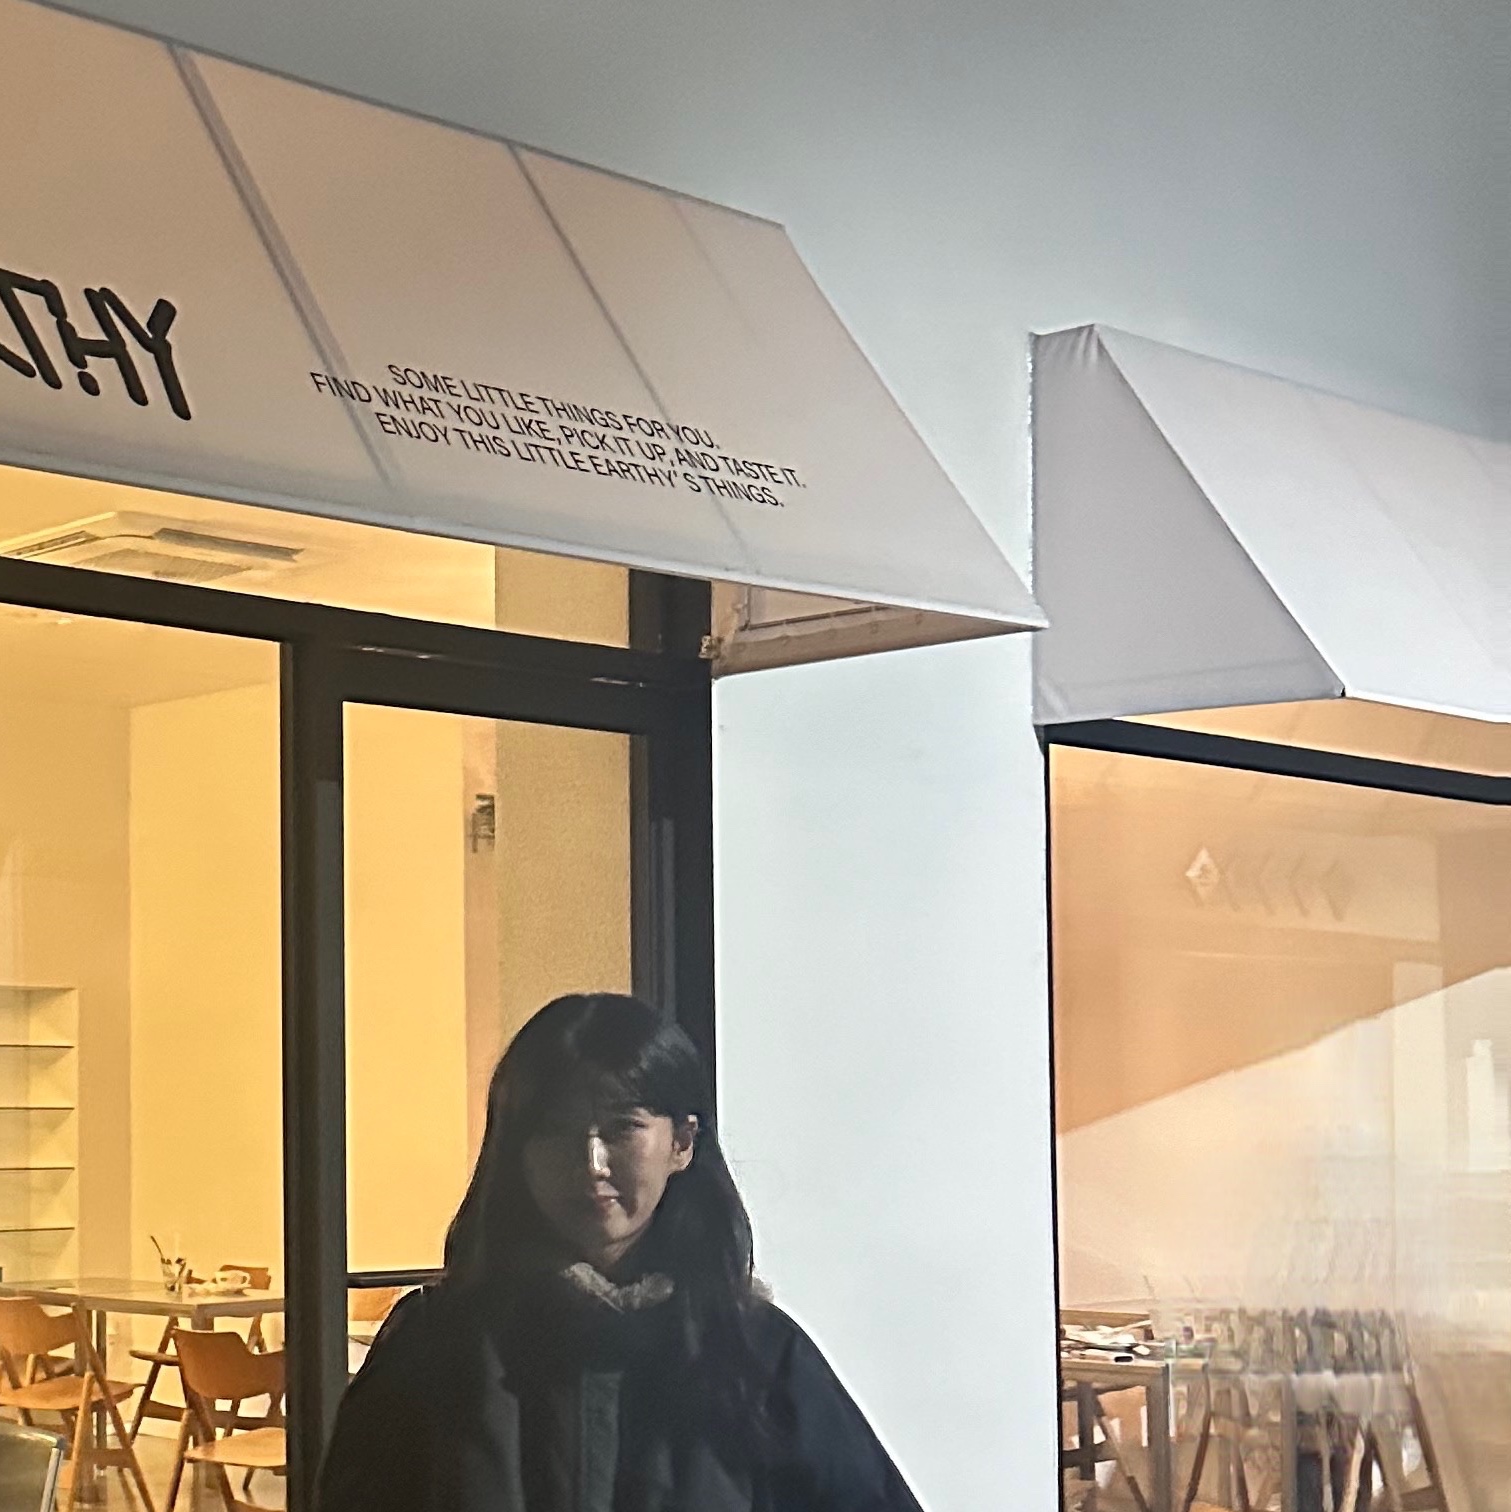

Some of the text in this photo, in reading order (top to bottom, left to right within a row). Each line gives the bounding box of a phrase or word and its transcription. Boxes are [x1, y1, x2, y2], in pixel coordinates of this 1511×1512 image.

[310, 372, 807, 488] FIND WHAT YOU LIKE, PICK IT UP, AND TASTE IT.
[388, 364, 720, 449] SOME LITTLE THINGS FOR YOU.
[374, 412, 450, 446] ENJOY
[452, 428, 511, 457] THIS
[511, 440, 591, 473] LITTLE
[698, 475, 785, 507] THINGS.
